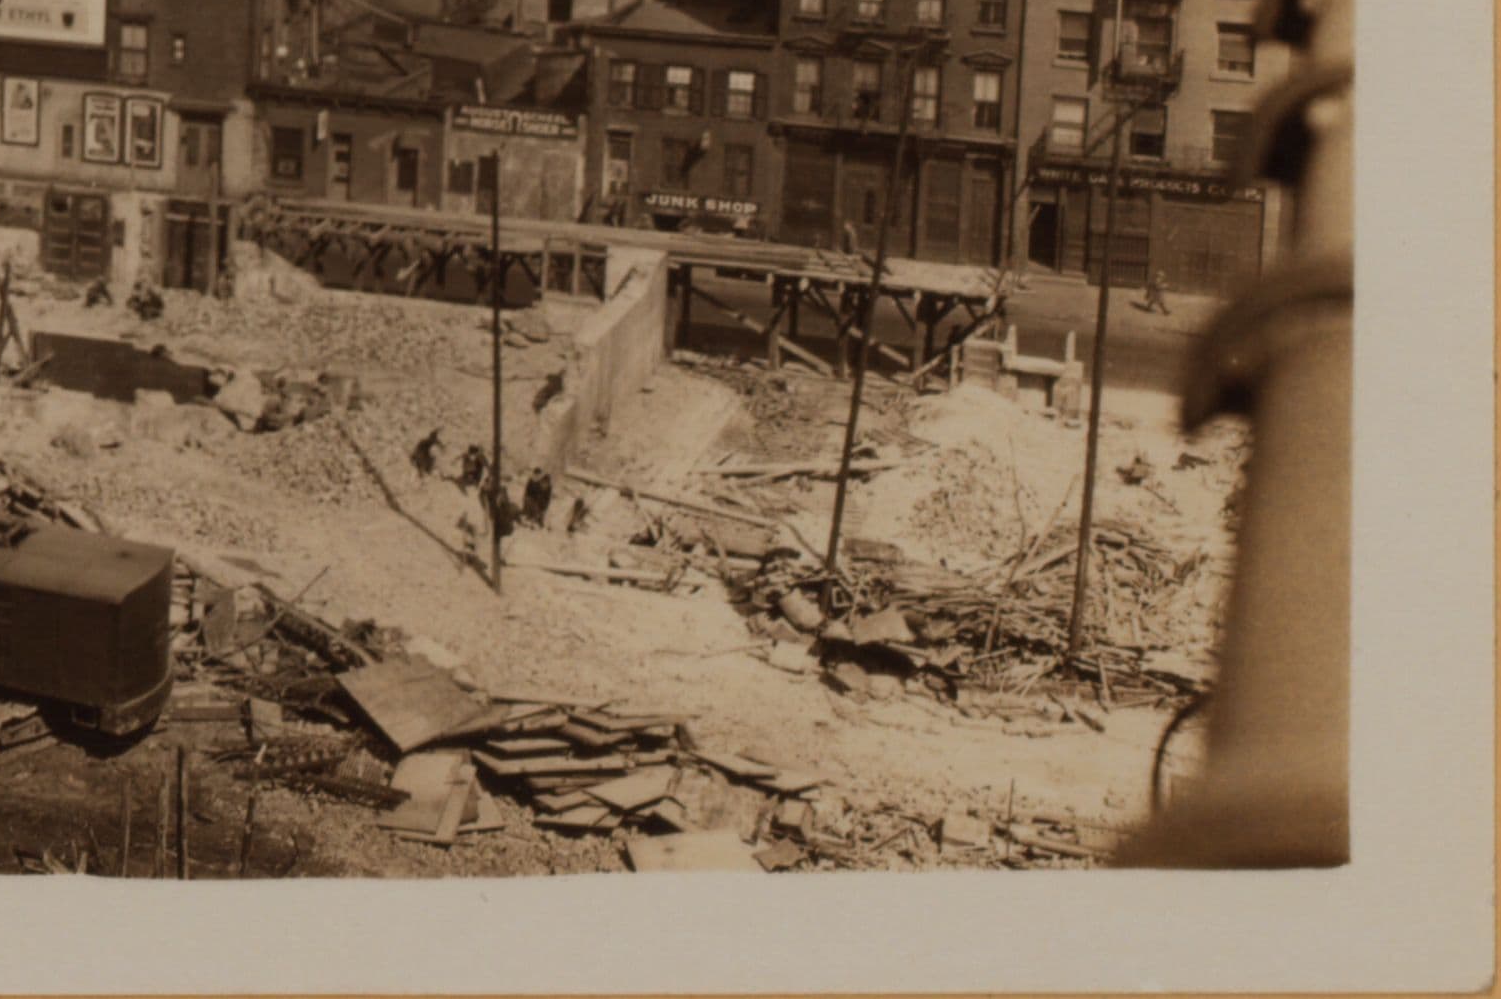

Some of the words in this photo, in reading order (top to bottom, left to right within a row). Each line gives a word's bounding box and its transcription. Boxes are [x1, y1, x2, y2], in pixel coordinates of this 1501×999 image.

[1130, 177, 1201, 194] PRODUCTS
[645, 193, 699, 210] JUNK
[705, 197, 758, 214] SHOP
